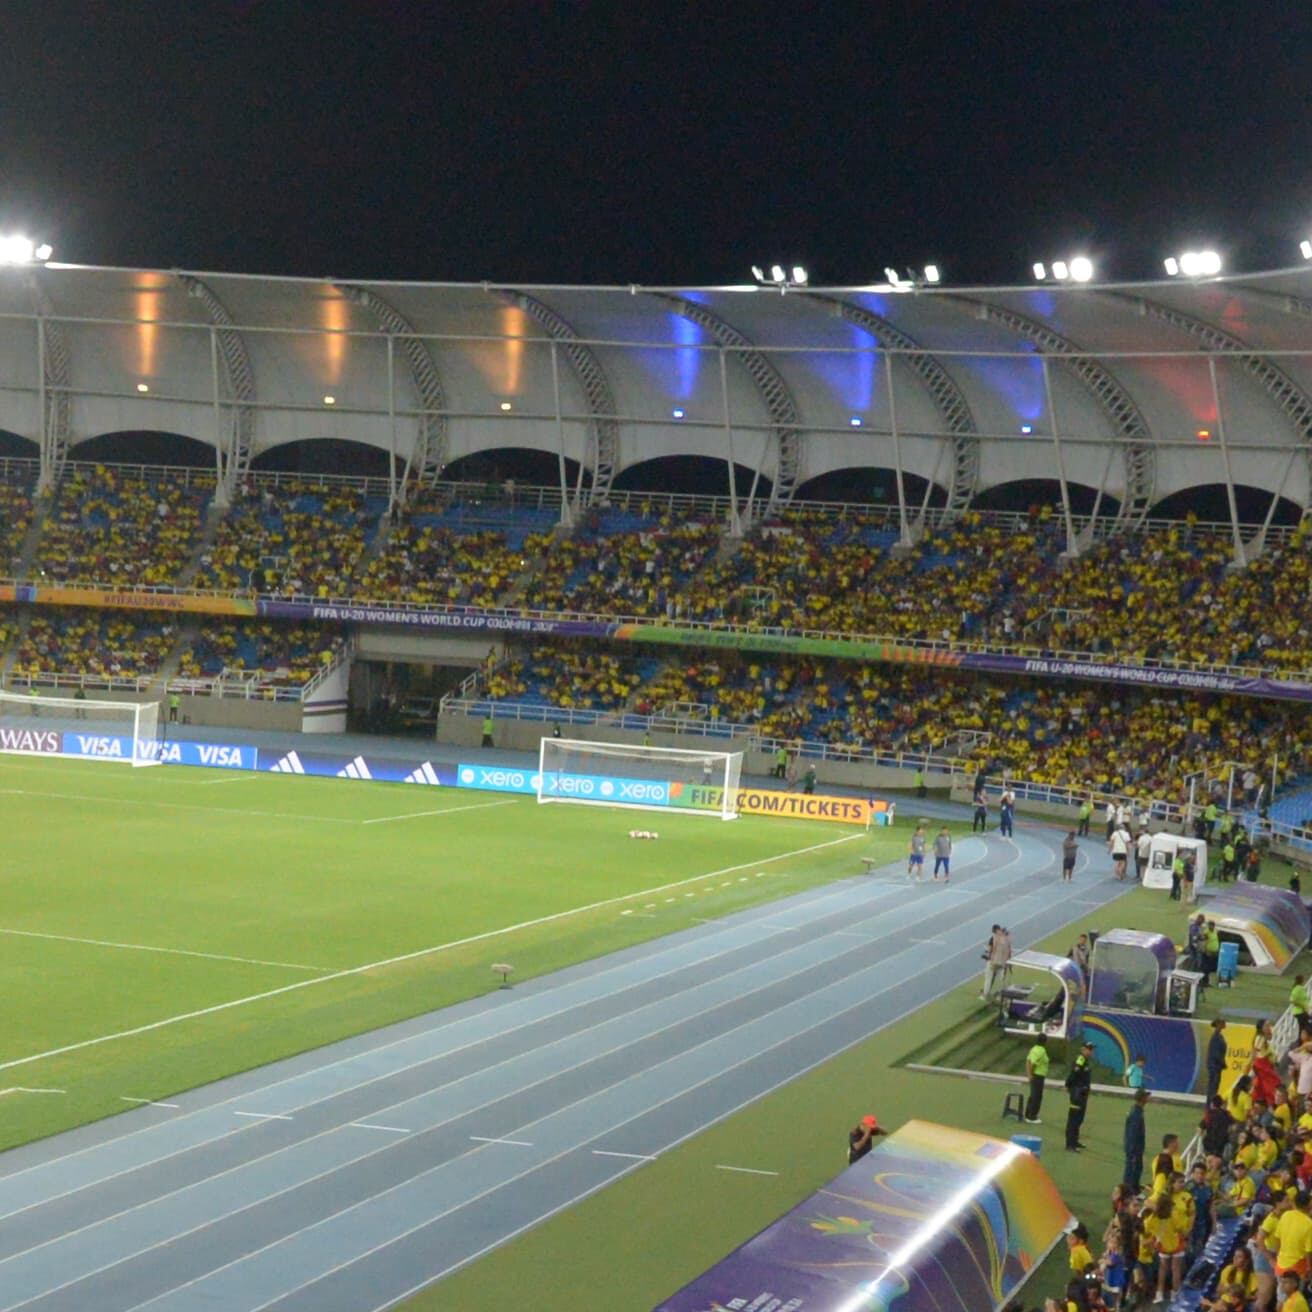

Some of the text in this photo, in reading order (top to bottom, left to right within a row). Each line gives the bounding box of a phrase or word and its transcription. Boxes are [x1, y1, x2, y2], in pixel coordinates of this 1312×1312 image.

[313, 608, 338, 618] FIFA
[340, 609, 364, 620] U-20
[365, 611, 419, 624] WOMEN'S
[421, 613, 461, 626] WORLD
[463, 616, 485, 628] CUP
[1025, 660, 1048, 671] FIFA
[77, 735, 122, 756] VISA
[138, 739, 182, 761] VISA
[197, 745, 243, 767] VISA
[480, 770, 525, 788] xero
[549, 775, 594, 793] xero
[620, 782, 665, 800] xero
